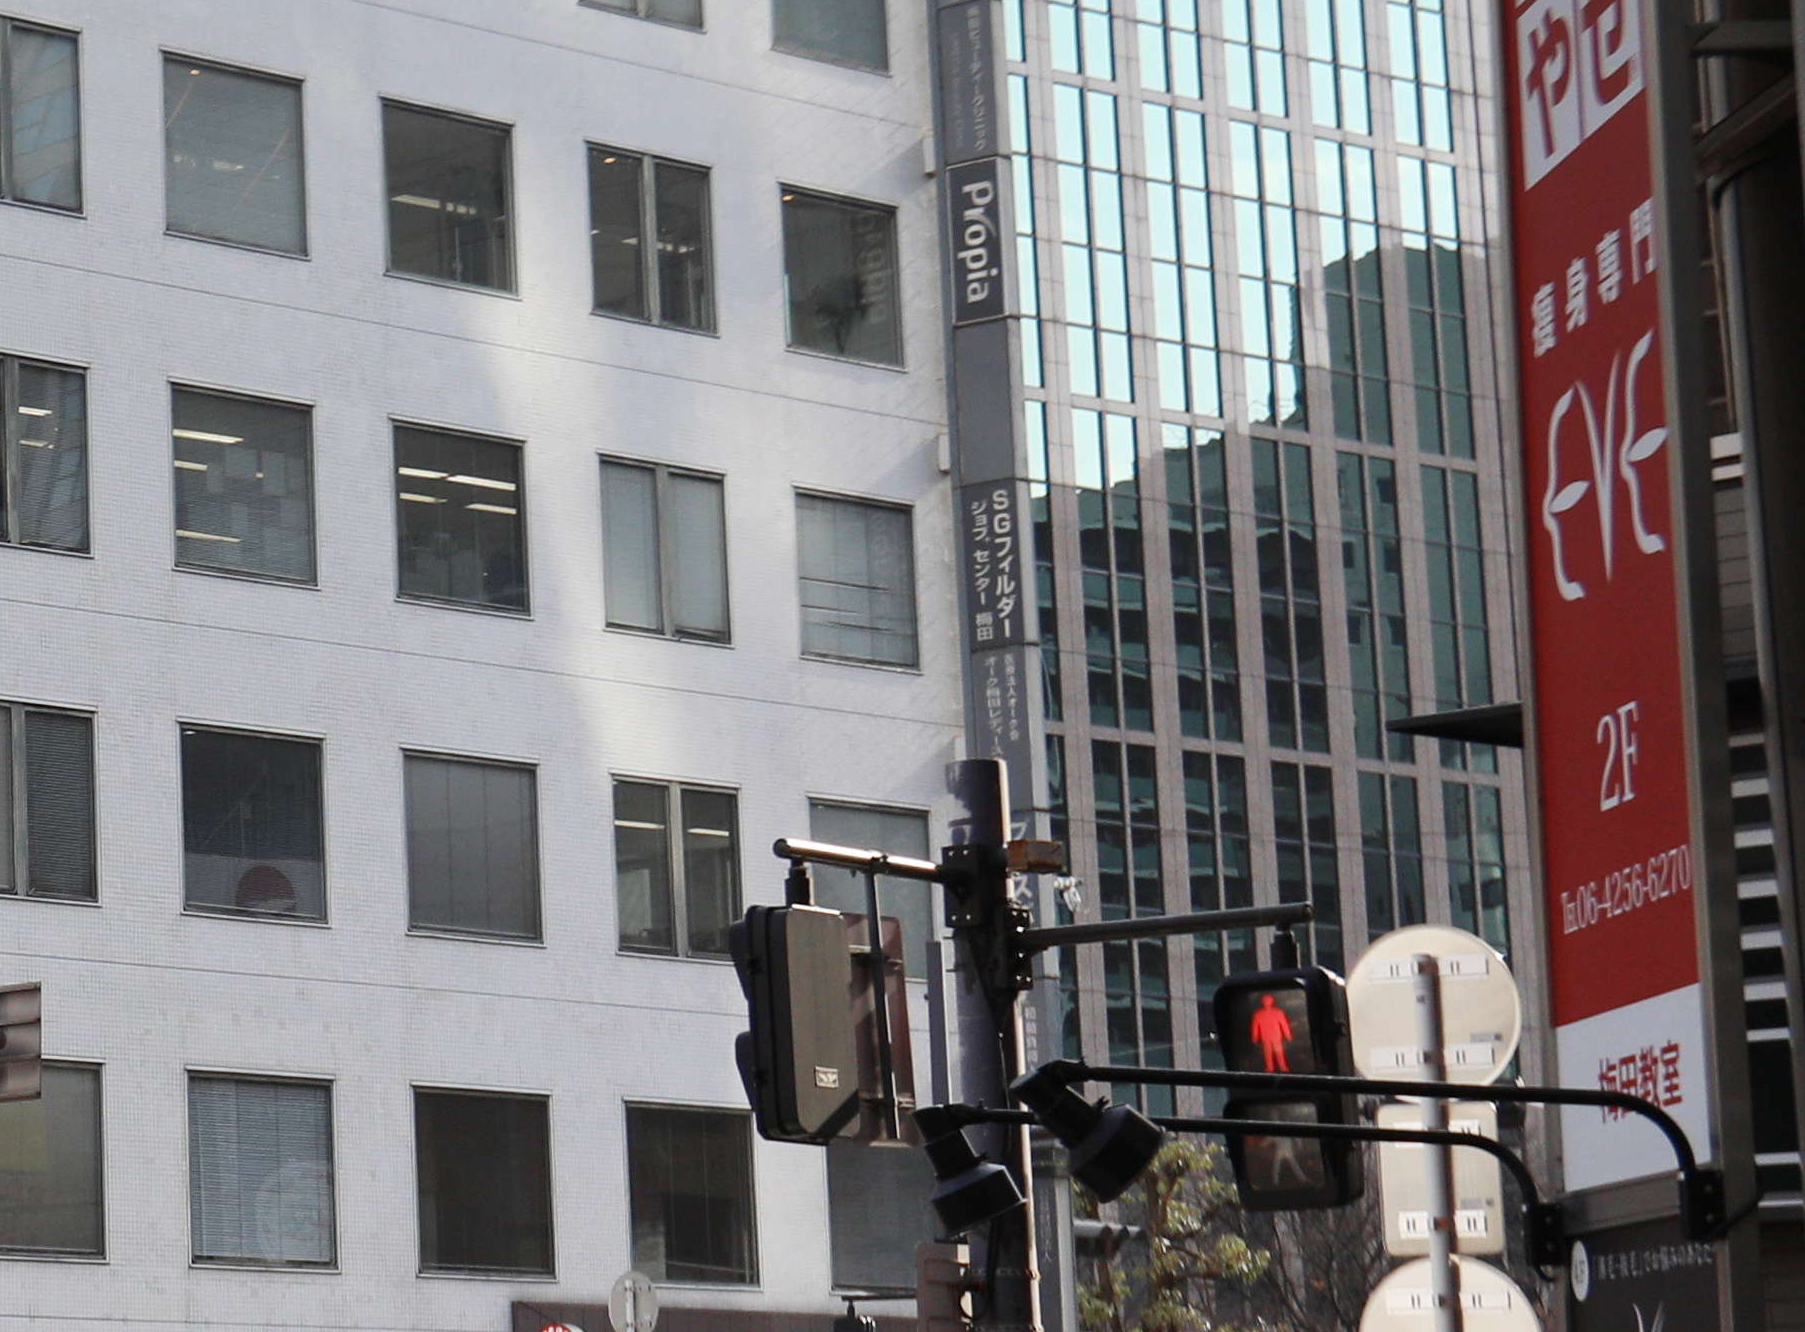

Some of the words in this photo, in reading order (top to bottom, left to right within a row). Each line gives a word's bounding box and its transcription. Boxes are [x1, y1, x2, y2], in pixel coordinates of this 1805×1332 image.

[1532, 197, 1659, 359] 痩身専門
[990, 489, 1015, 638] SGフィルダー
[1596, 700, 1640, 814] 2F
[1598, 1040, 1683, 1125] 梅田教室
